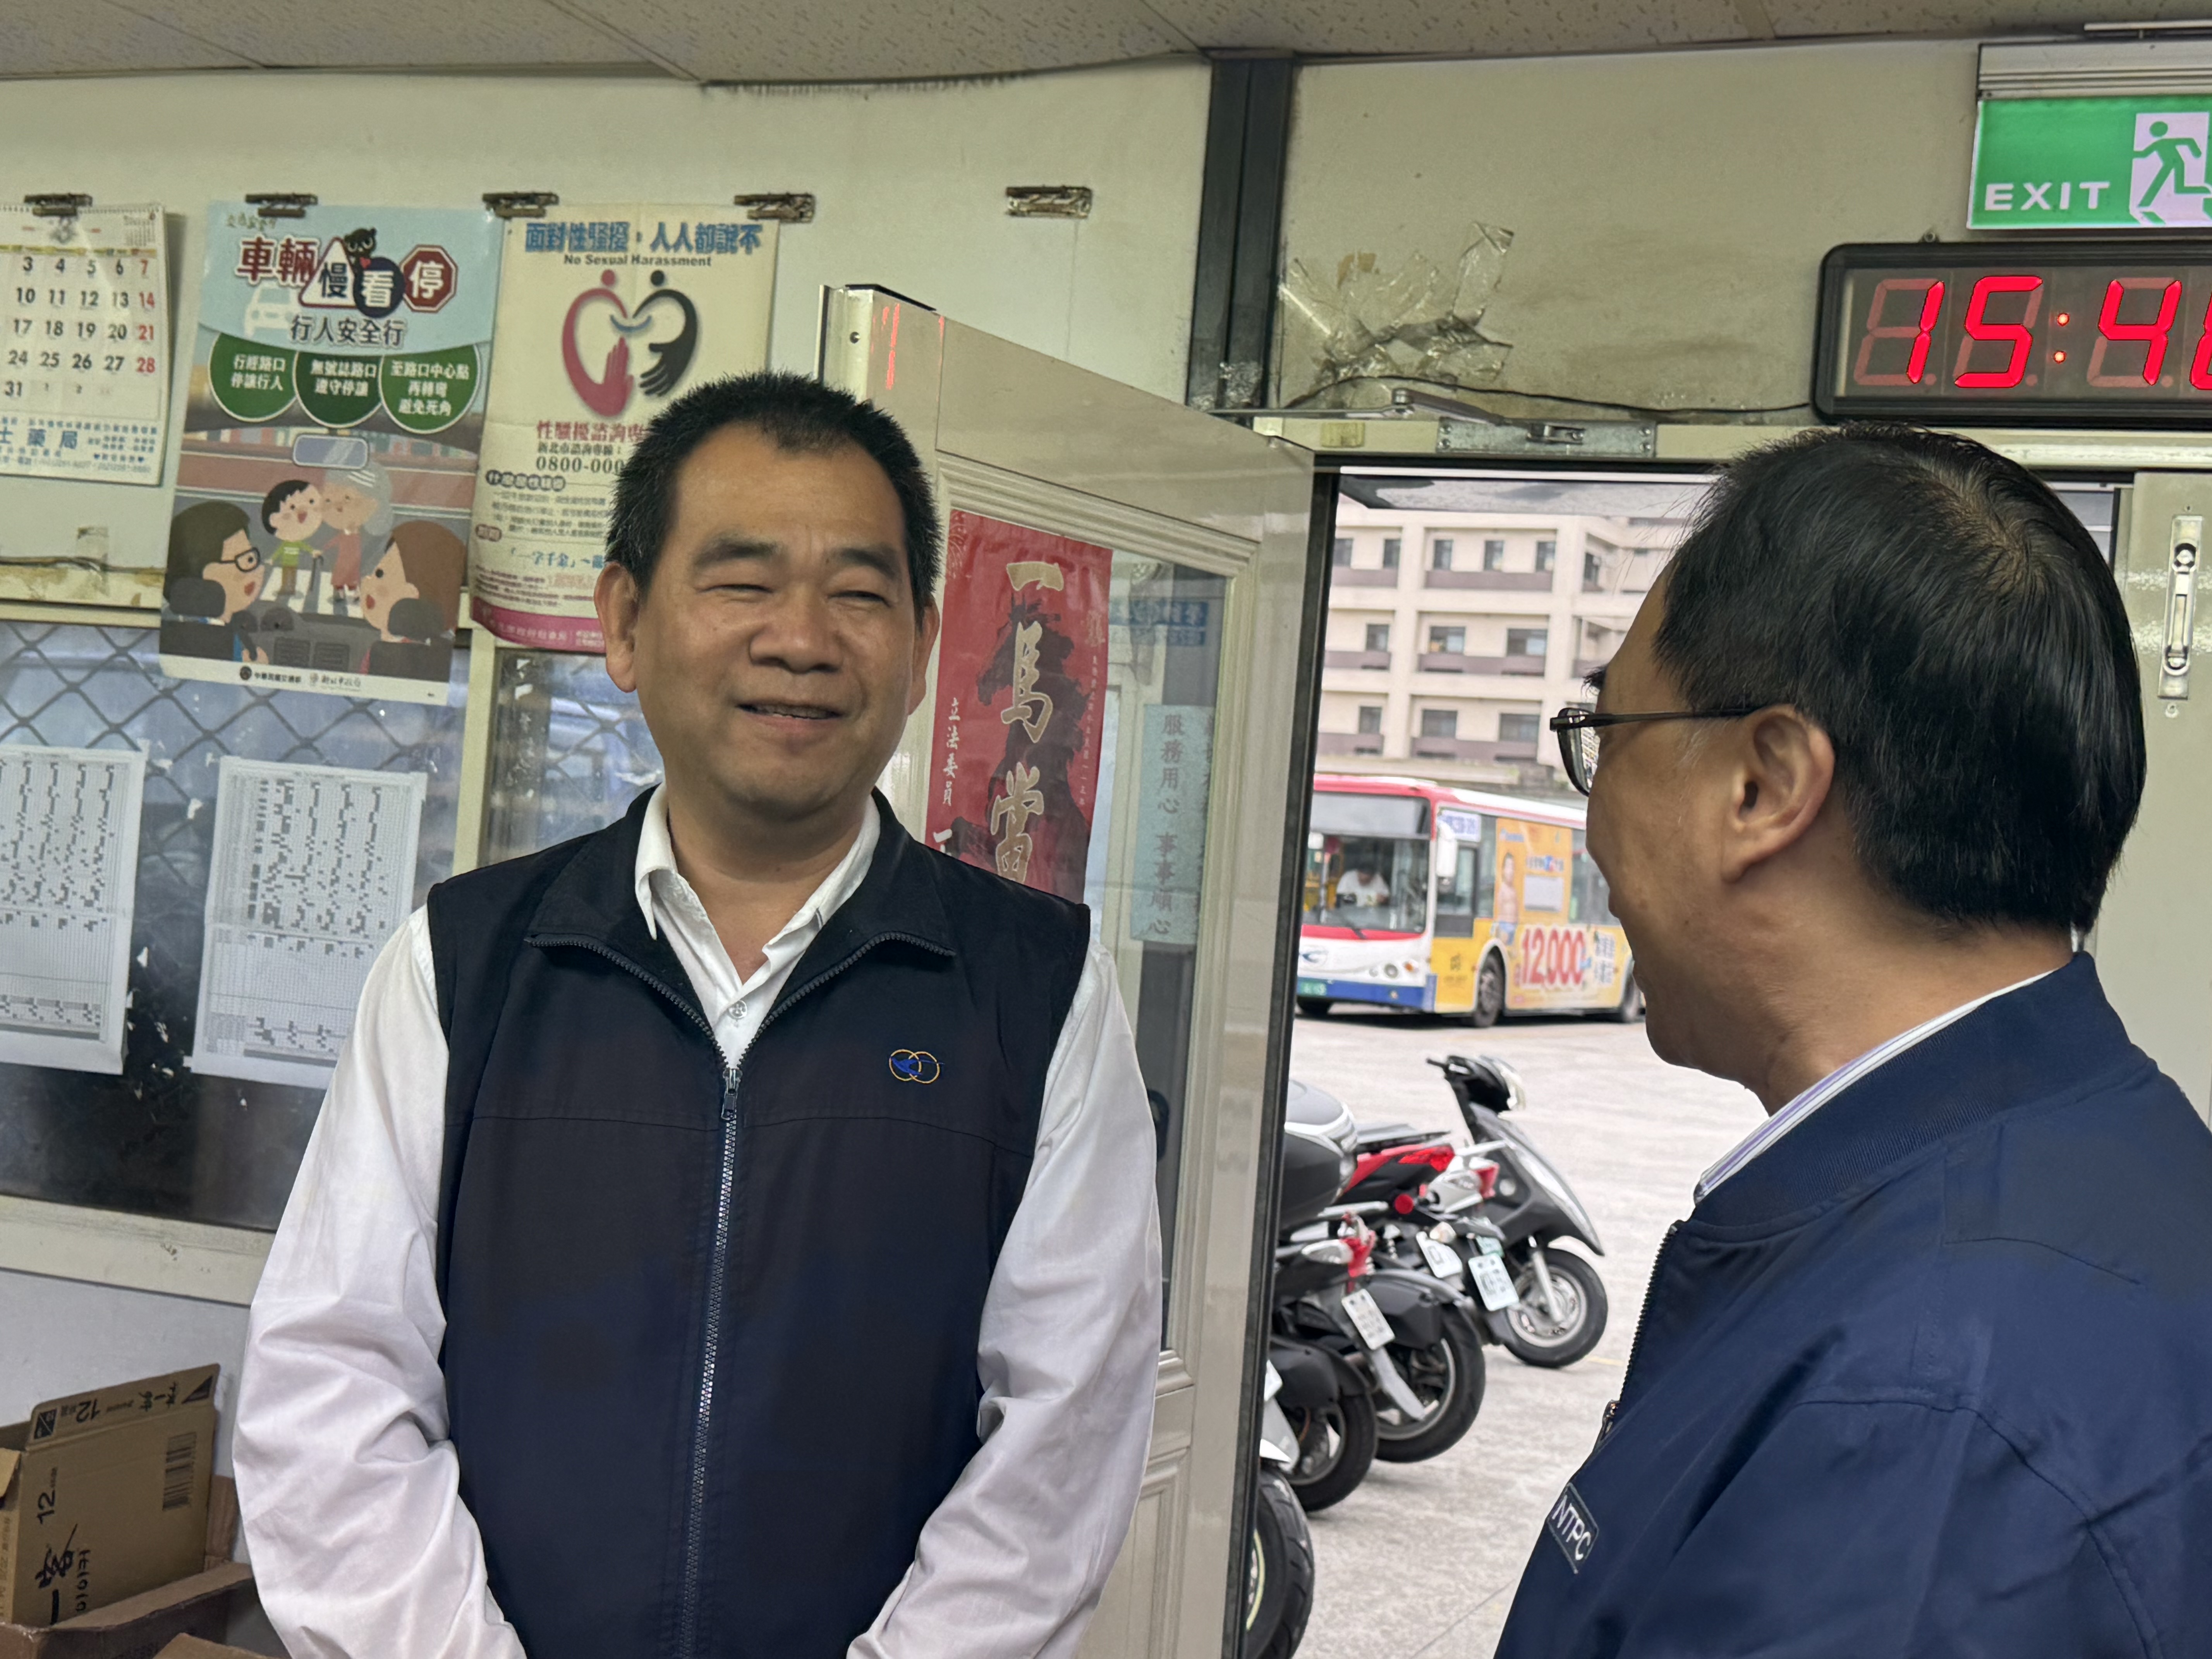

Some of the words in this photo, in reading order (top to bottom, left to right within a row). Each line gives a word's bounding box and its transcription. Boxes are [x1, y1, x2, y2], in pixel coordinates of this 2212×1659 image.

[1984, 181, 2110, 211] EXIT
[23, 256, 33, 271] 3
[55, 258, 65, 273] 4
[87, 259, 96, 274] 5
[117, 259, 124, 275] 6
[141, 259, 148, 275] 7
[237, 236, 319, 283] 車輛
[564, 254, 581, 265] No
[586, 254, 627, 265] Sexual
[631, 255, 711, 266] Harassment
[318, 262, 348, 298] 慢
[361, 270, 395, 308] 看
[409, 260, 445, 299] 停
[17, 287, 35, 304] 10
[49, 290, 65, 305] 11
[81, 291, 99, 306] 12
[113, 292, 129, 308] 13
[139, 291, 155, 309] 14
[14, 319, 32, 335] 17
[46, 321, 63, 337] 18
[78, 322, 96, 338] 19
[108, 324, 127, 340] 20
[139, 324, 155, 340] 21
[291, 314, 405, 346] 行人安全行
[1906, 274, 2212, 390] 15:4
[8, 350, 28, 366] 24
[40, 352, 60, 368] 25
[72, 354, 92, 370] 26
[104, 355, 124, 372] 27
[137, 357, 156, 373] 28
[311, 359, 377, 378] 無號誌路口
[391, 360, 469, 380] 至路口中心點
[5, 380, 22, 397] 31
[231, 372, 283, 392] 停讓行人
[398, 398, 452, 416] 避免死角
[942, 697, 961, 807] 立法委員
[1158, 714, 1184, 814] 服務用心
[1150, 832, 1178, 936] 事事順心
[77, 1399, 101, 1423] 12
[37, 1491, 55, 1525] 12
[1552, 1495, 1592, 1561] NTPC
